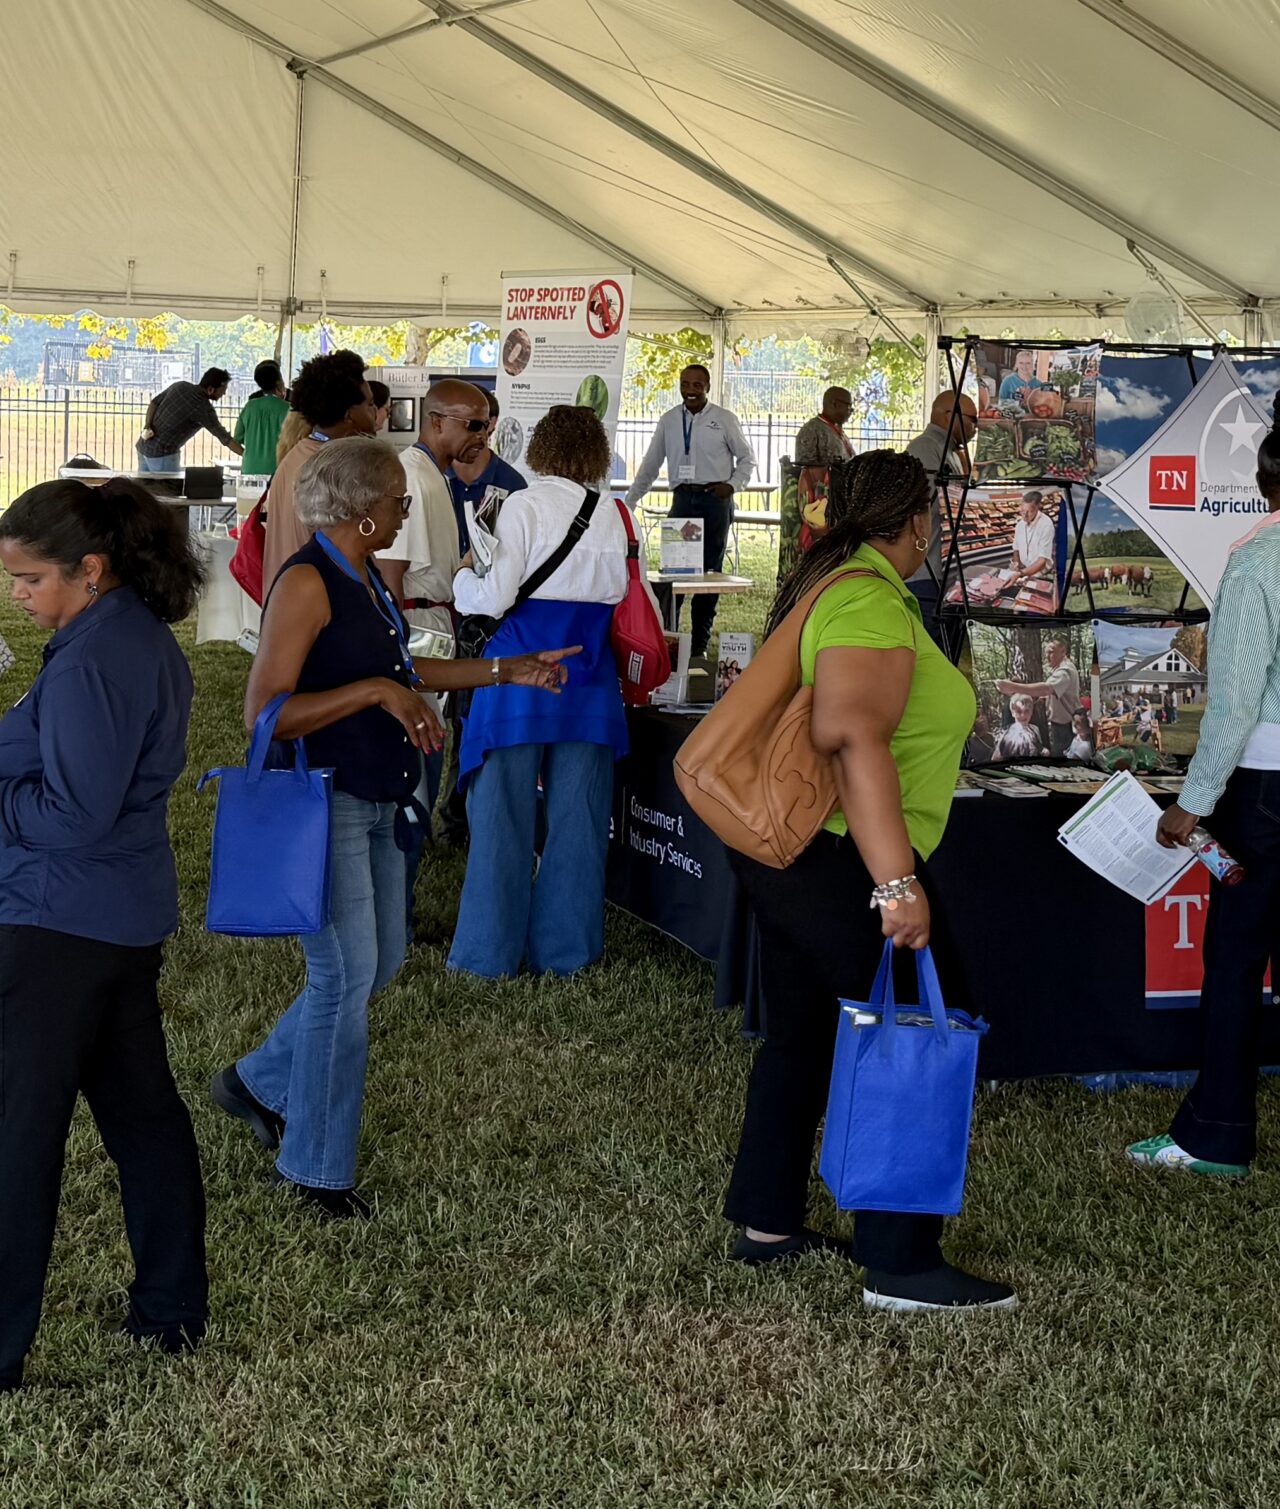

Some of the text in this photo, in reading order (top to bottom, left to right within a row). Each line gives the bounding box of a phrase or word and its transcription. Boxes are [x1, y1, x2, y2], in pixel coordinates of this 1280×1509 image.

[508, 287, 586, 303] STOP SPOTTED
[506, 305, 577, 320] LANTERNFLY
[1156, 470, 1187, 491] TN
[1200, 482, 1258, 495] Department
[1200, 497, 1270, 517] Agricultu
[631, 795, 676, 832] Consumer
[677, 815, 685, 837] &
[1164, 894, 1210, 949] T
